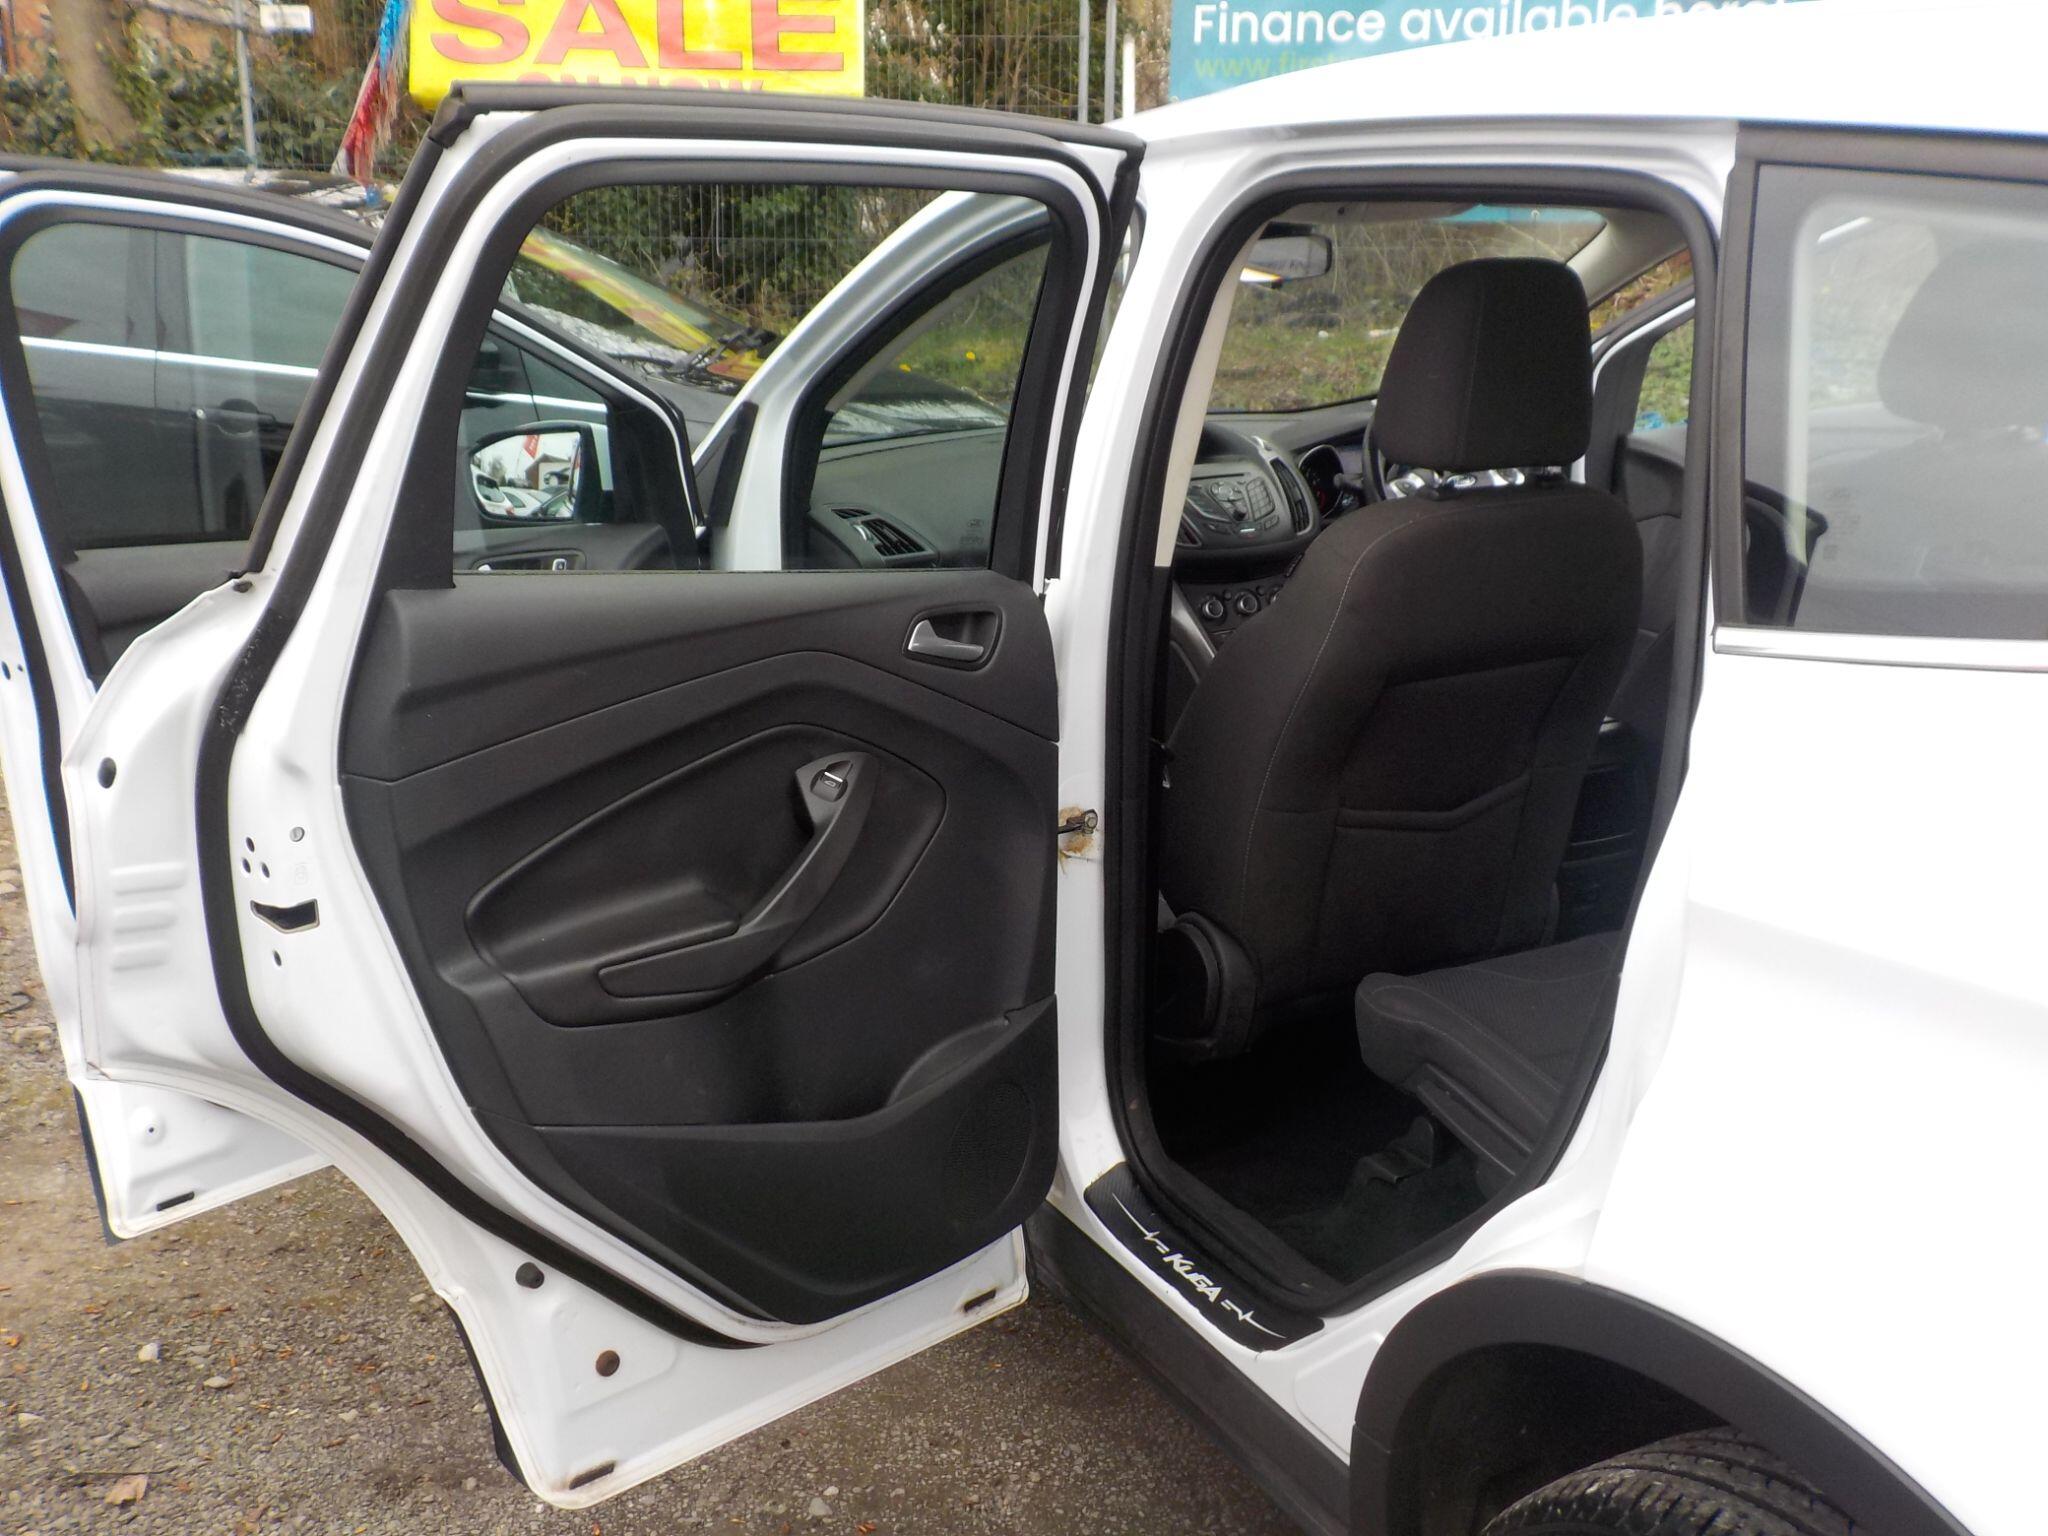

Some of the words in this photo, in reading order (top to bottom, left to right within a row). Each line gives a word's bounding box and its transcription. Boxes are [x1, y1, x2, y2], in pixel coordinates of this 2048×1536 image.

[430, 0, 845, 71] SALE
[1194, 1, 1386, 44] Finance
[1399, 0, 1638, 42] available
[1162, 1253, 1223, 1303] KUGA
